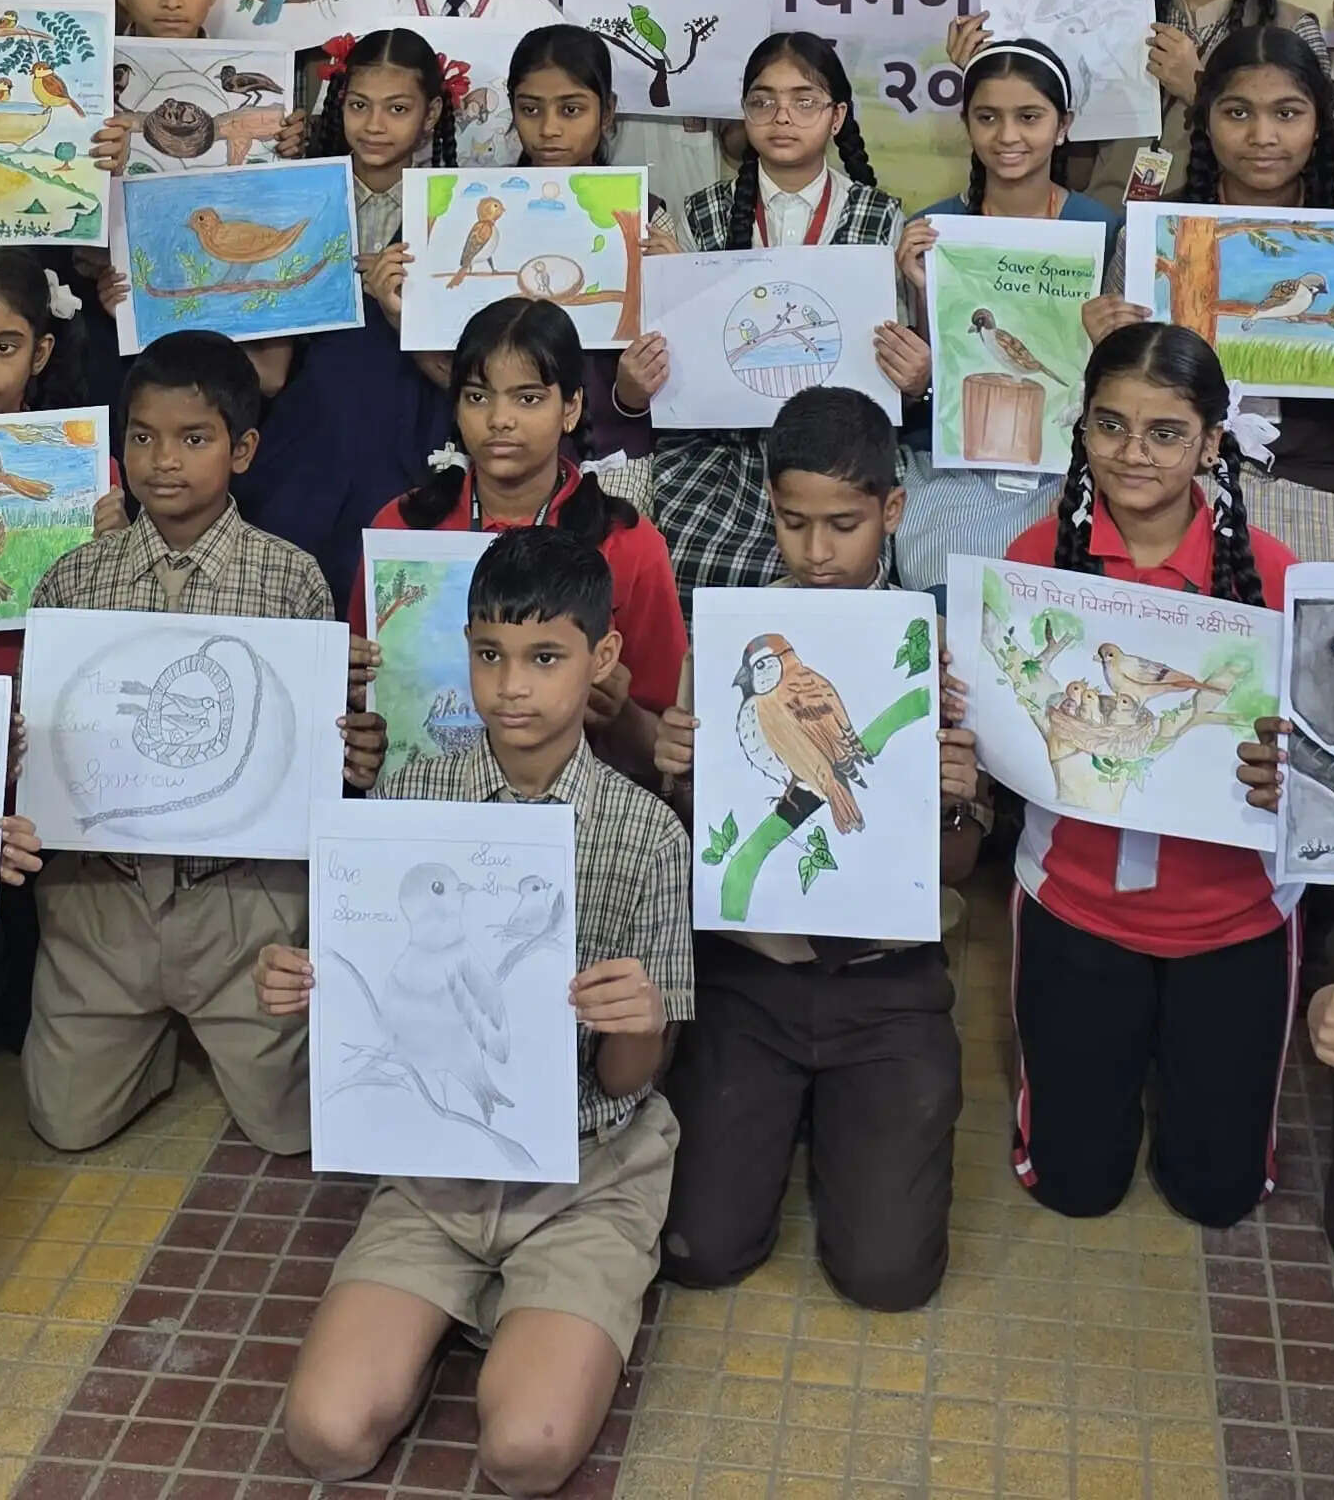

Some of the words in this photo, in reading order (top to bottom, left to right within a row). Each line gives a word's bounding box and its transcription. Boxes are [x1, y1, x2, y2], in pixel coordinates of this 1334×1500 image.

[883, 60, 964, 113] २०
[997, 255, 1036, 276] Save
[993, 276, 1031, 294] Save
[1038, 281, 1091, 300] Nature
